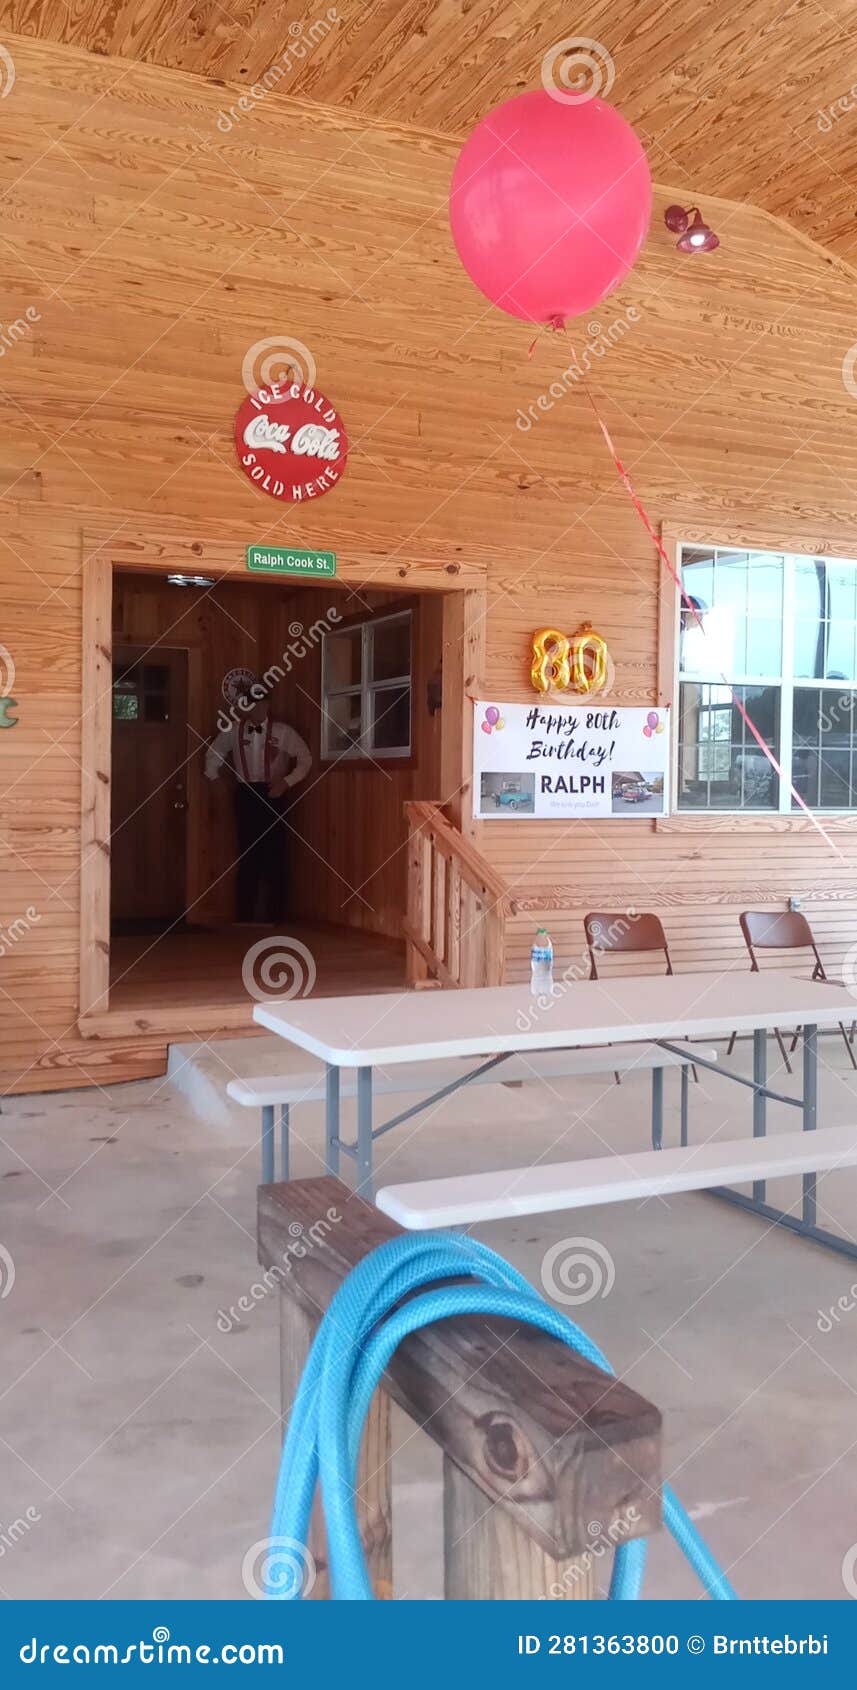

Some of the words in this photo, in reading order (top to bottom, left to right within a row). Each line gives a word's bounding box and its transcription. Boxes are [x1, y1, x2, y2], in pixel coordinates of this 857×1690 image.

[250, 384, 282, 410] ICE
[289, 384, 336, 422] COLD
[243, 414, 291, 454] Coca
[290, 423, 340, 461] Cola
[242, 454, 284, 496] SOLD
[292, 466, 338, 500] HERE
[253, 553, 284, 567] Ralph
[287, 556, 313, 569] Cook
[316, 558, 330, 570] St.
[531, 627, 607, 693] 80
[526, 707, 580, 736] Happy
[585, 710, 621, 731] 80th
[526, 738, 616, 767] Birthday!
[540, 775, 605, 794] RALPH
